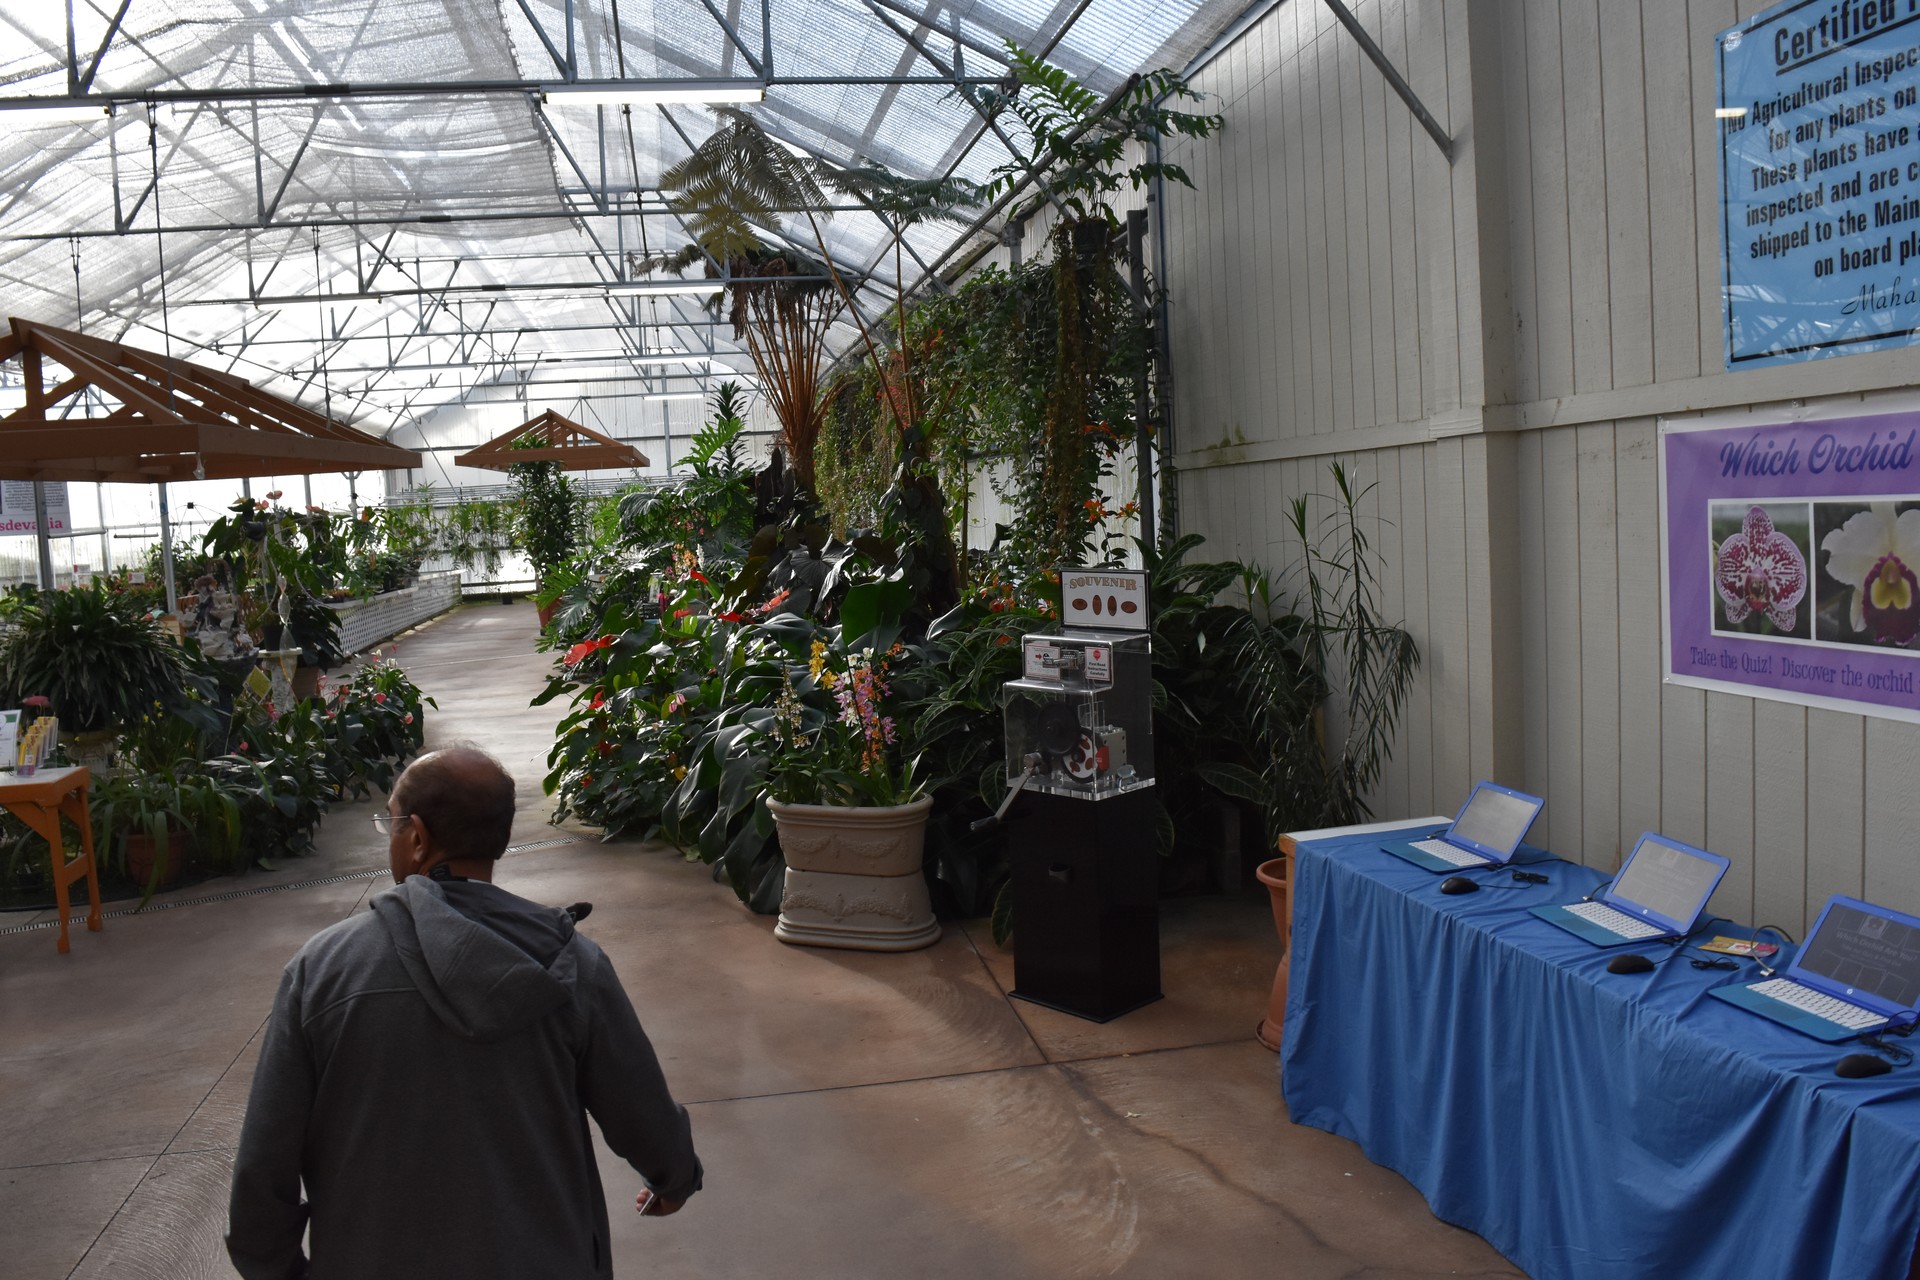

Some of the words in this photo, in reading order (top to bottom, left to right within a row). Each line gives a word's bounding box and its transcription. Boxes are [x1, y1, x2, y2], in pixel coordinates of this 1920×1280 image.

[1775, 0, 1895, 66] Certified
[1728, 111, 1745, 135] No
[1752, 66, 1848, 128] Agricultural
[1855, 46, 1920, 87] Inspec
[1769, 126, 1791, 153] for
[1796, 117, 1823, 146] any
[1829, 97, 1886, 136] plants
[1894, 85, 1916, 110] on
[1752, 162, 1796, 191] These
[1803, 142, 1857, 182] plants
[1865, 126, 1908, 157] have
[1746, 182, 1823, 227] inspected
[1830, 171, 1861, 204] and
[1869, 168, 1899, 193] are
[1750, 222, 1809, 259] shipped
[1815, 220, 1832, 242] to
[1839, 209, 1867, 236] the
[1875, 194, 1920, 228] Main
[1814, 257, 1833, 278] on
[1840, 236, 1892, 272] board
[1840, 277, 1920, 315] Maha
[1720, 433, 1800, 478] Which
[1808, 429, 1917, 474] Orchid
[0, 518, 63, 531] sdevaia
[1069, 576, 1137, 591] SOUVENIR
[1690, 646, 1717, 666] Take
[1720, 650, 1738, 670] the
[1741, 655, 1772, 675] Quiz!
[1782, 657, 1836, 683] Discover
[1842, 664, 1862, 686] the
[1868, 669, 1914, 694] orchid
